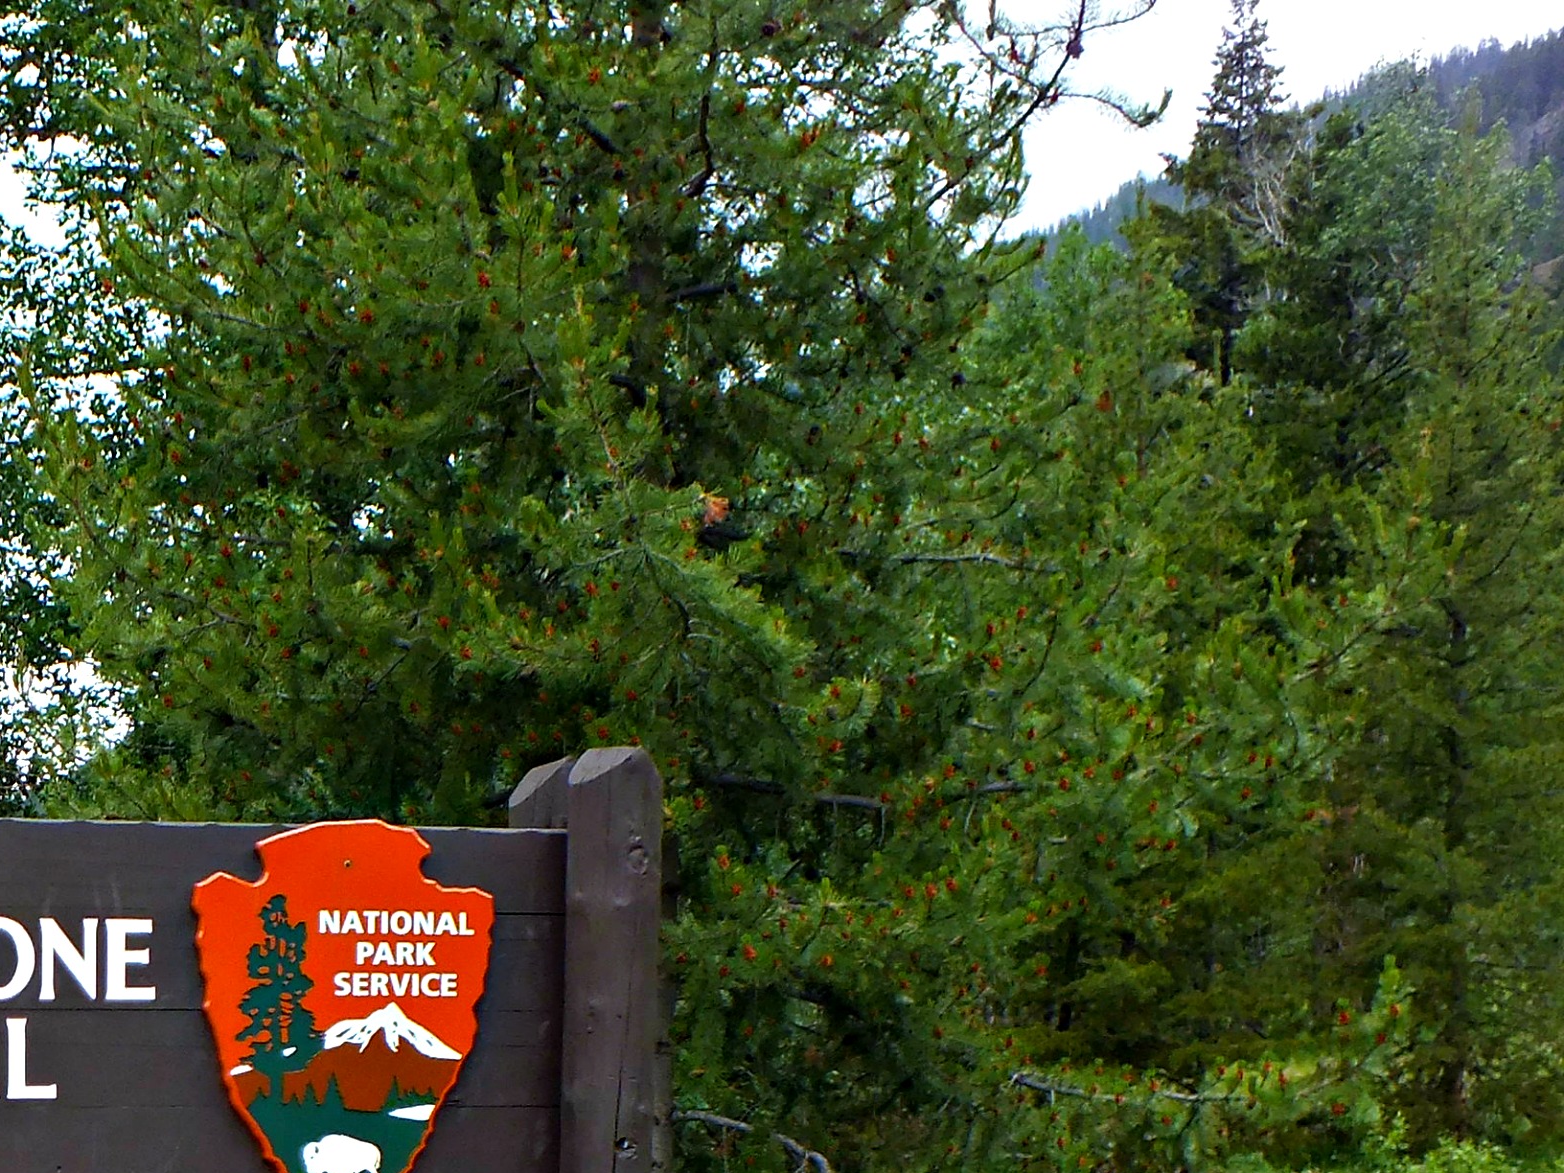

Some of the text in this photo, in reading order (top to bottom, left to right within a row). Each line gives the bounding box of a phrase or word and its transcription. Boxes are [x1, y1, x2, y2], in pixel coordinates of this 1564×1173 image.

[318, 910, 475, 936] NATIONAL
[356, 941, 436, 966] PARK
[333, 972, 458, 997] SERVICE
